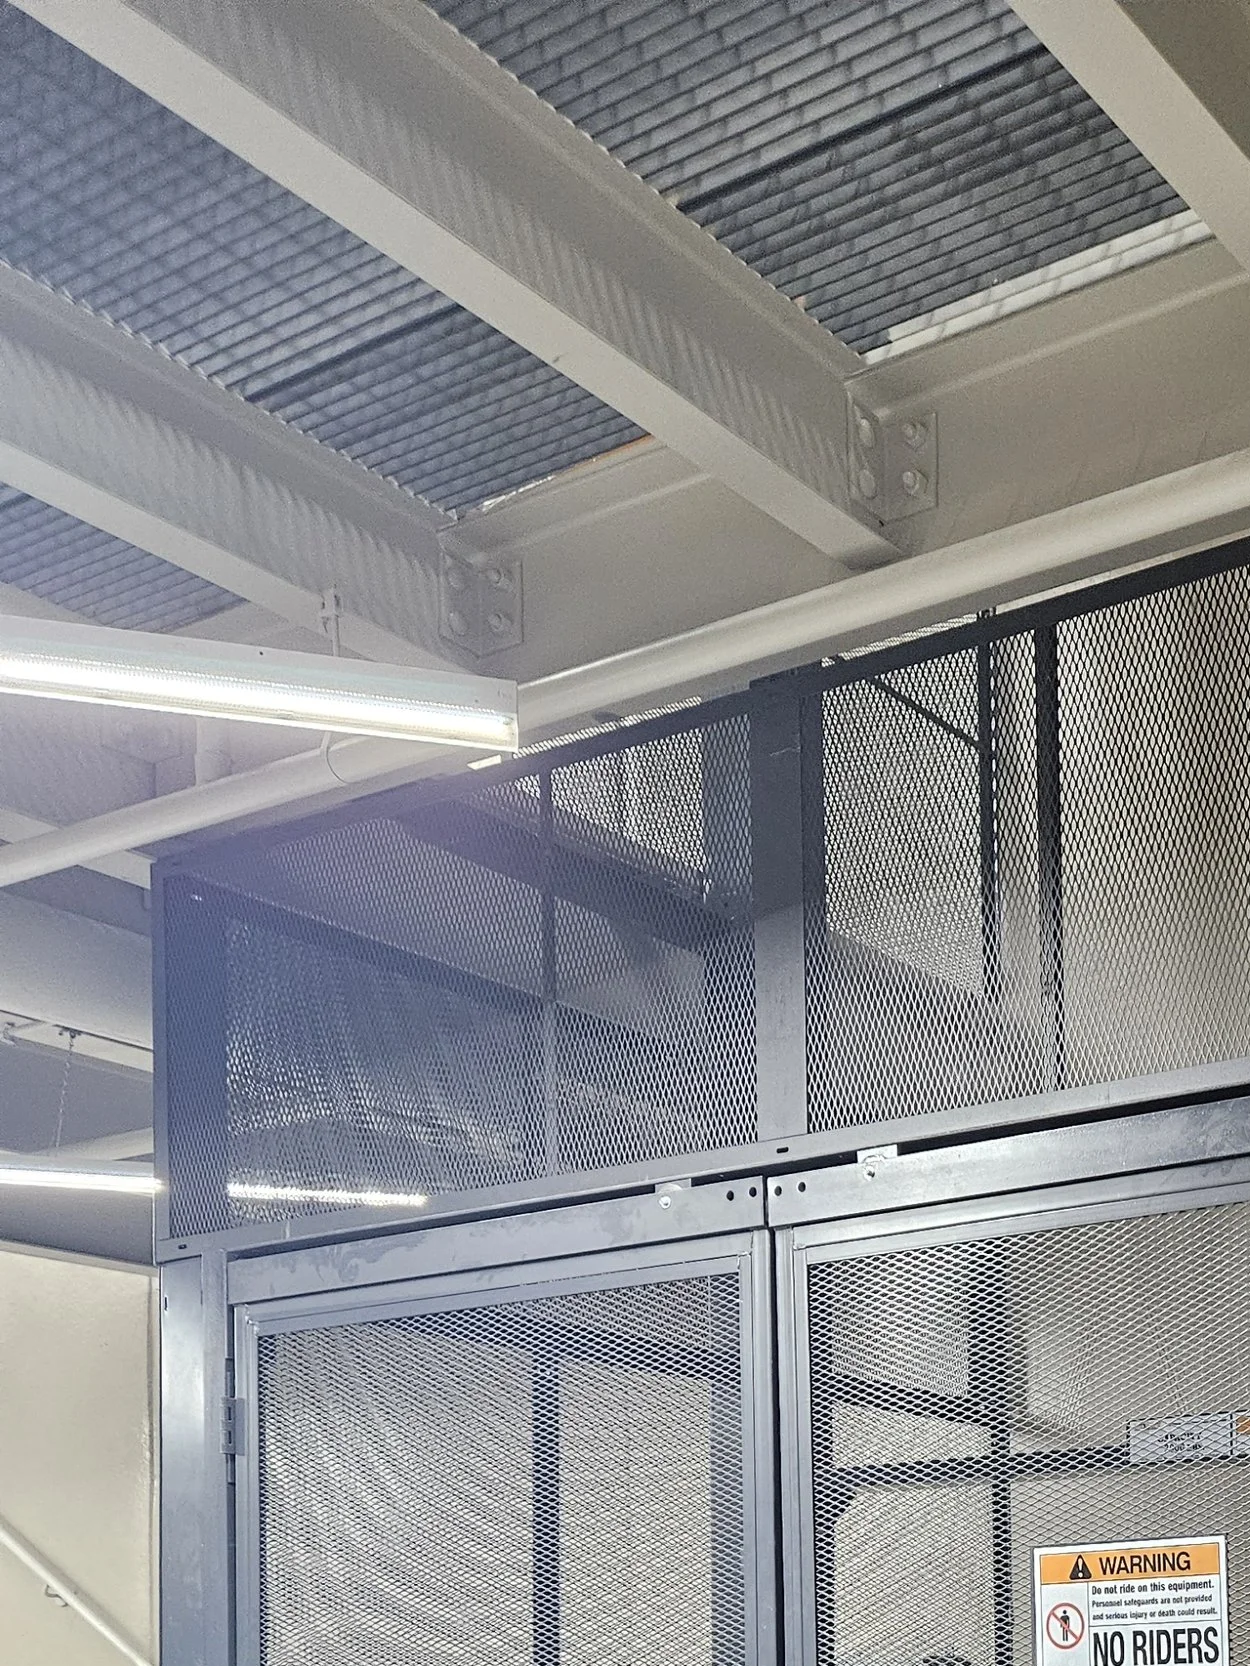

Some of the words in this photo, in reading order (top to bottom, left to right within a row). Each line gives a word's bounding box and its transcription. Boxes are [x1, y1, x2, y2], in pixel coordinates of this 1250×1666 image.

[1099, 1552, 1191, 1575] WARNING
[1092, 1585, 1102, 1595] Do
[1104, 1584, 1117, 1594] not
[1120, 1583, 1135, 1594] ride
[1138, 1584, 1148, 1592] on
[1150, 1581, 1166, 1592] this
[1168, 1579, 1214, 1593] equipment.
[1092, 1598, 1122, 1608] Personnel
[1124, 1597, 1158, 1607] safeguards
[1173, 1595, 1183, 1604] not
[1185, 1594, 1212, 1604] provided
[1092, 1612, 1103, 1620] and
[1105, 1611, 1128, 1620] serious
[1130, 1610, 1147, 1619] injury
[1158, 1609, 1176, 1617] death
[1177, 1608, 1195, 1616] could
[1196, 1607, 1218, 1615] result.
[1133, 1626, 1220, 1666] RIDERS
